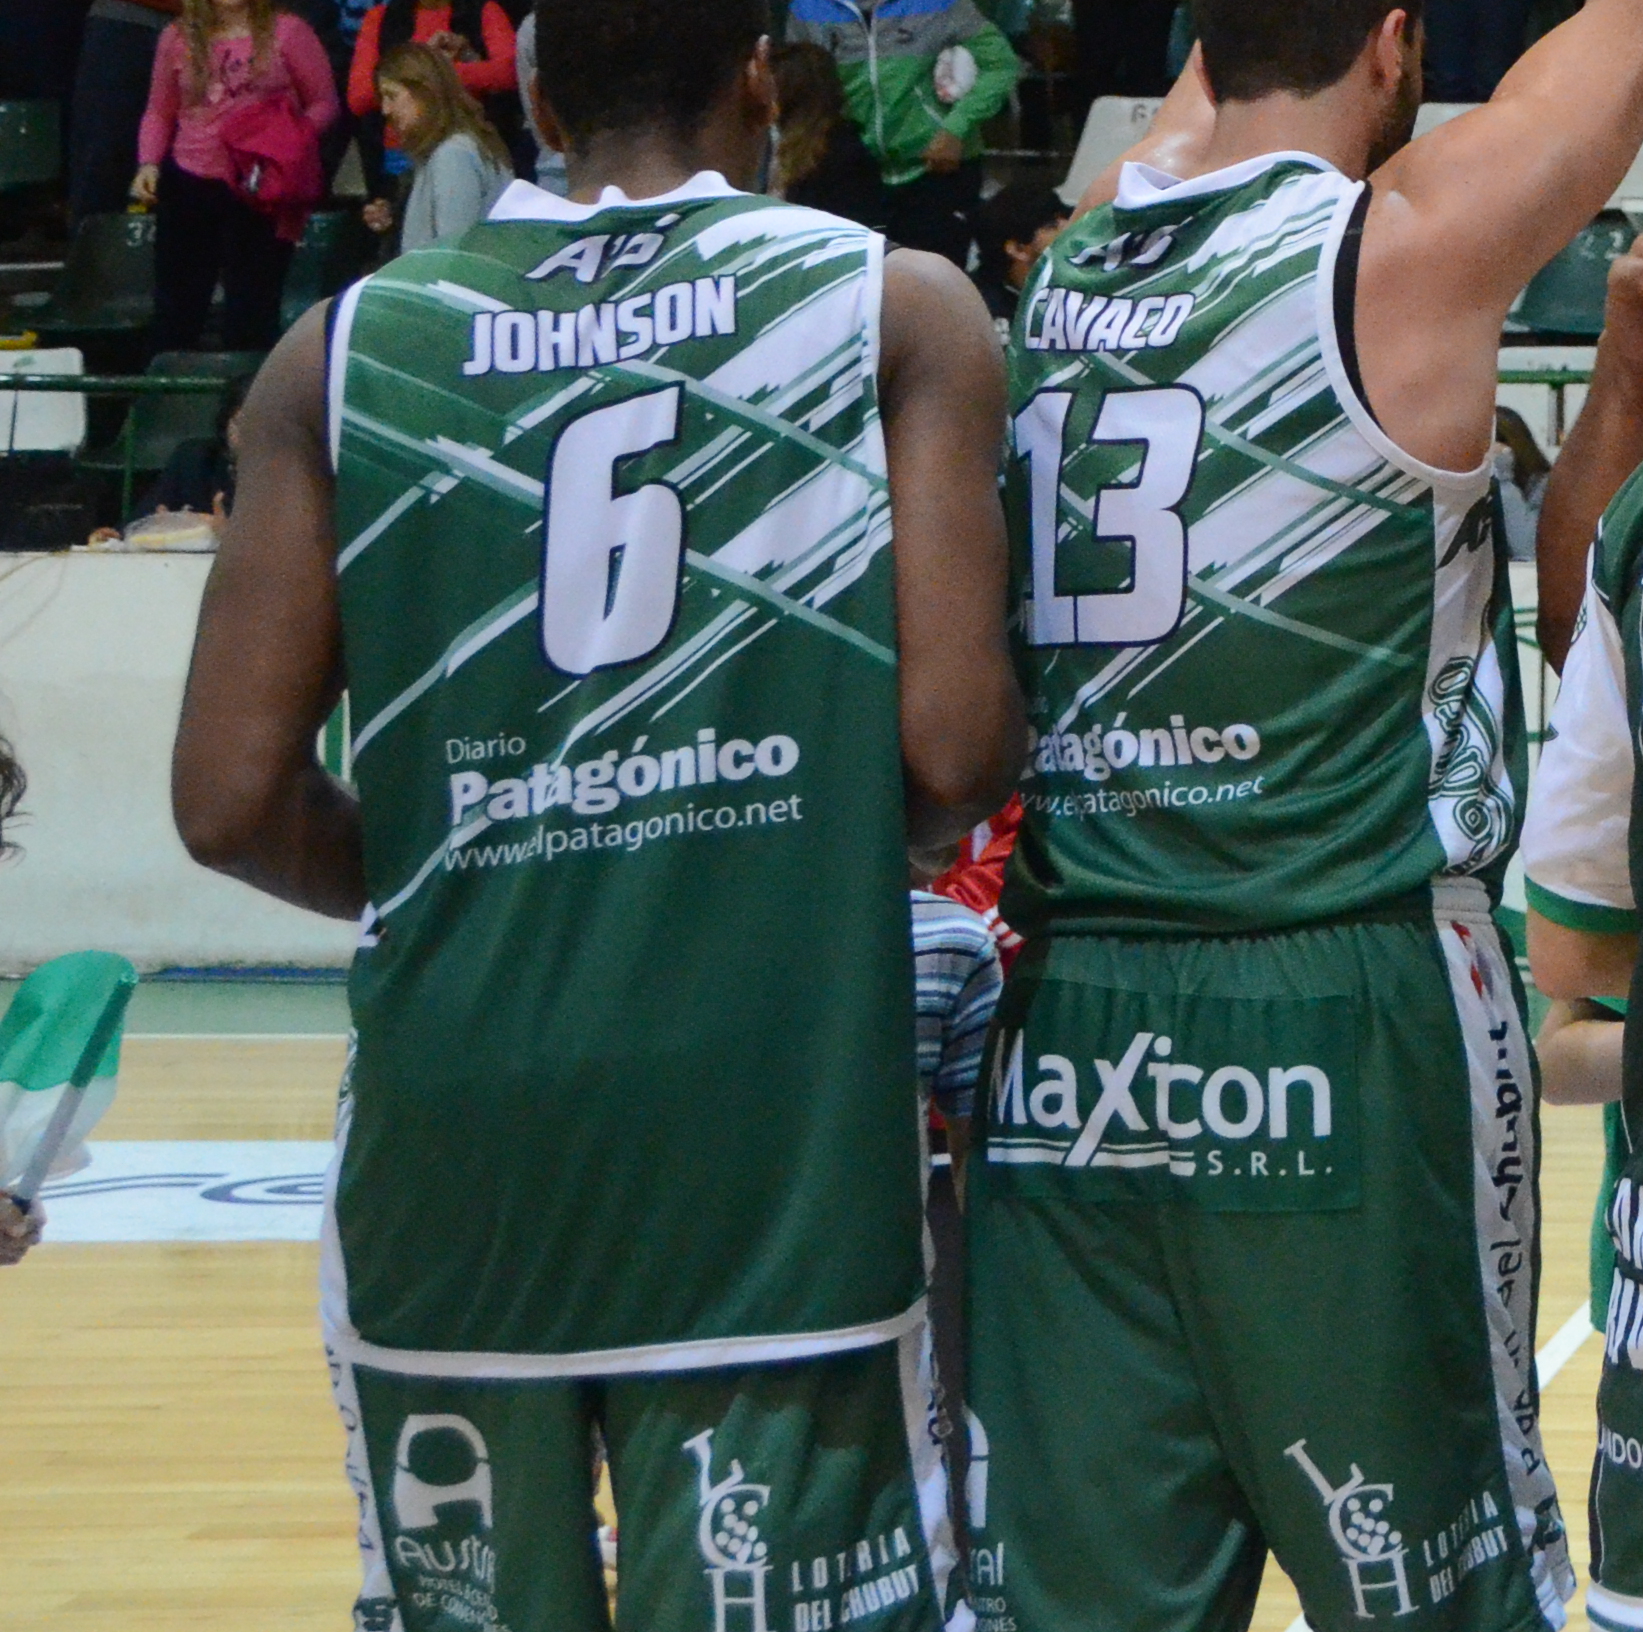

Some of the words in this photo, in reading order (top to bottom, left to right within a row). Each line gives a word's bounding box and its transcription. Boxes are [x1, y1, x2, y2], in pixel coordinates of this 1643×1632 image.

[462, 274, 738, 377] JOHNSON
[1024, 287, 1196, 353] CAVACO
[536, 380, 688, 678] 6
[1013, 380, 1206, 648] 13
[445, 732, 527, 764] Diario
[450, 727, 800, 826] Patagónico
[794, 1599, 833, 1632] DEL
